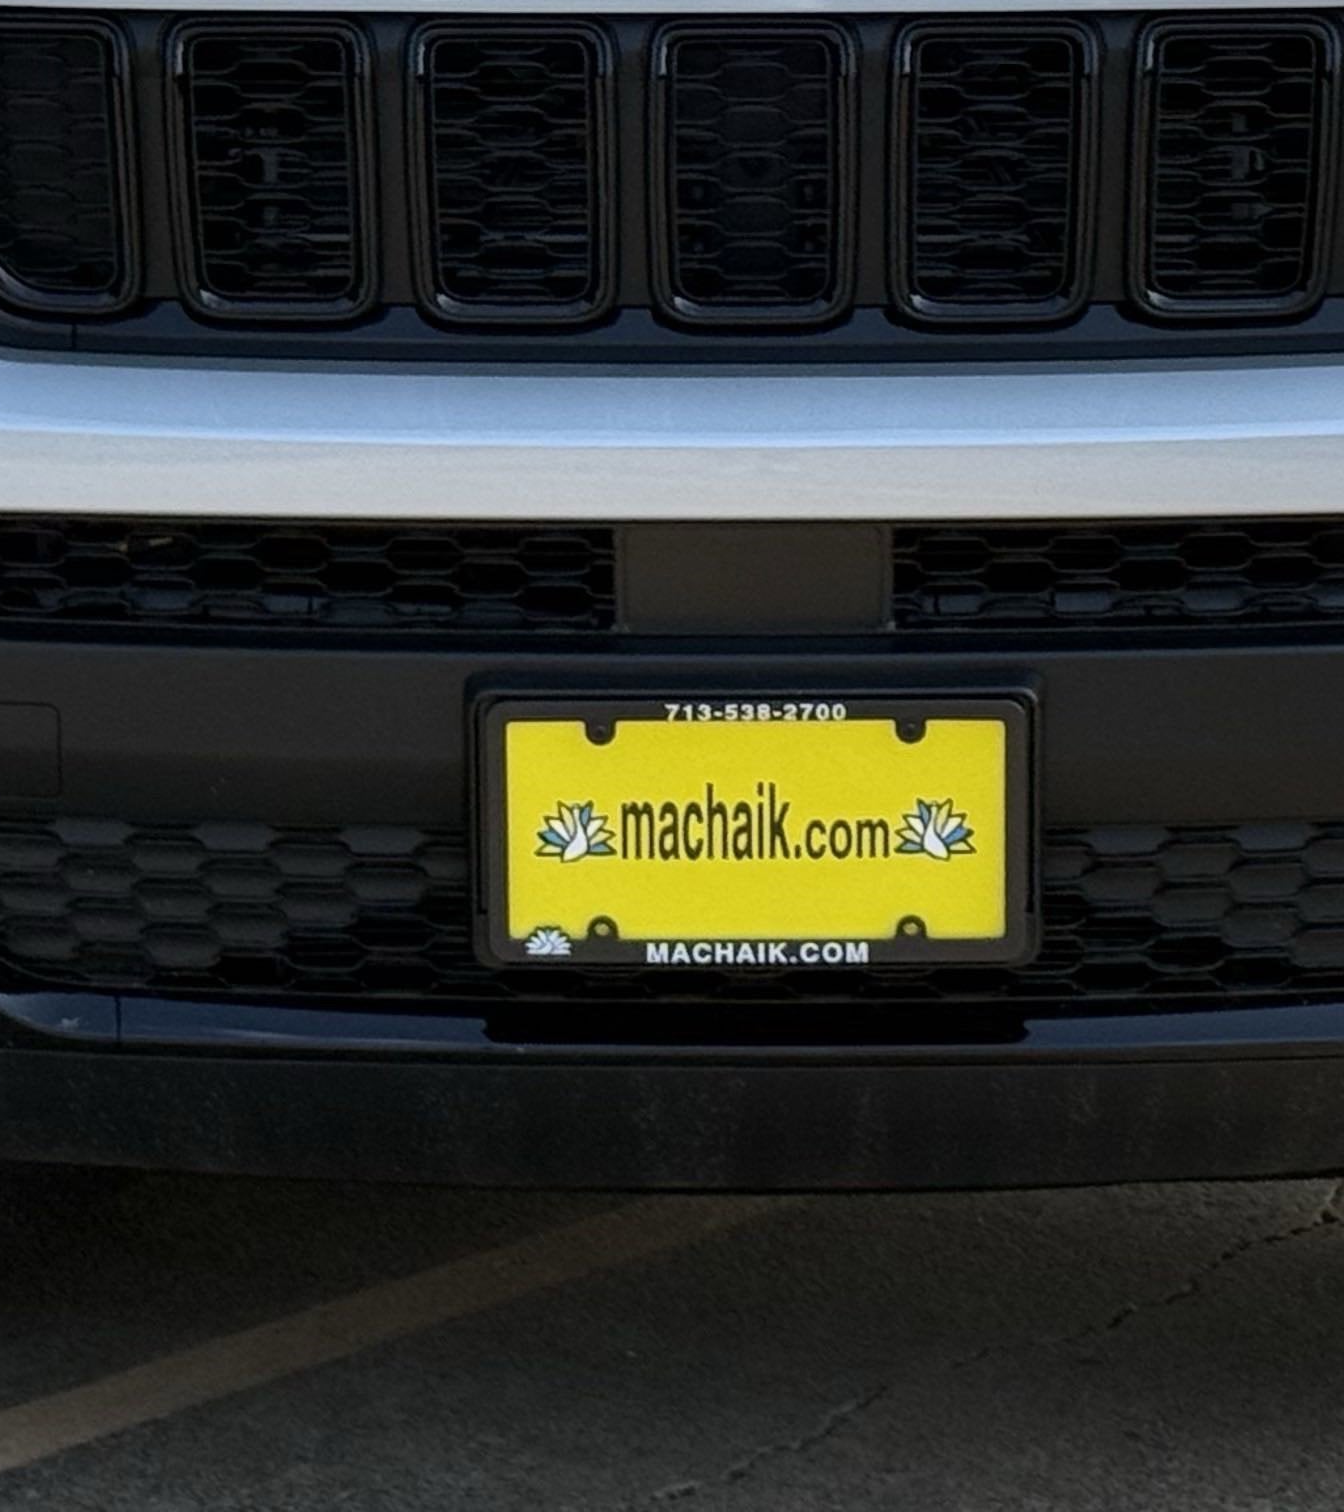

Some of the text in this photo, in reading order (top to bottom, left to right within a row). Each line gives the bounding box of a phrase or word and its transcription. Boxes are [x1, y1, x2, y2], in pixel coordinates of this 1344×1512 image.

[664, 702, 848, 722] 713-538-2700
[620, 782, 891, 861] machaik.com
[645, 941, 870, 964] MACHAIK.COM
